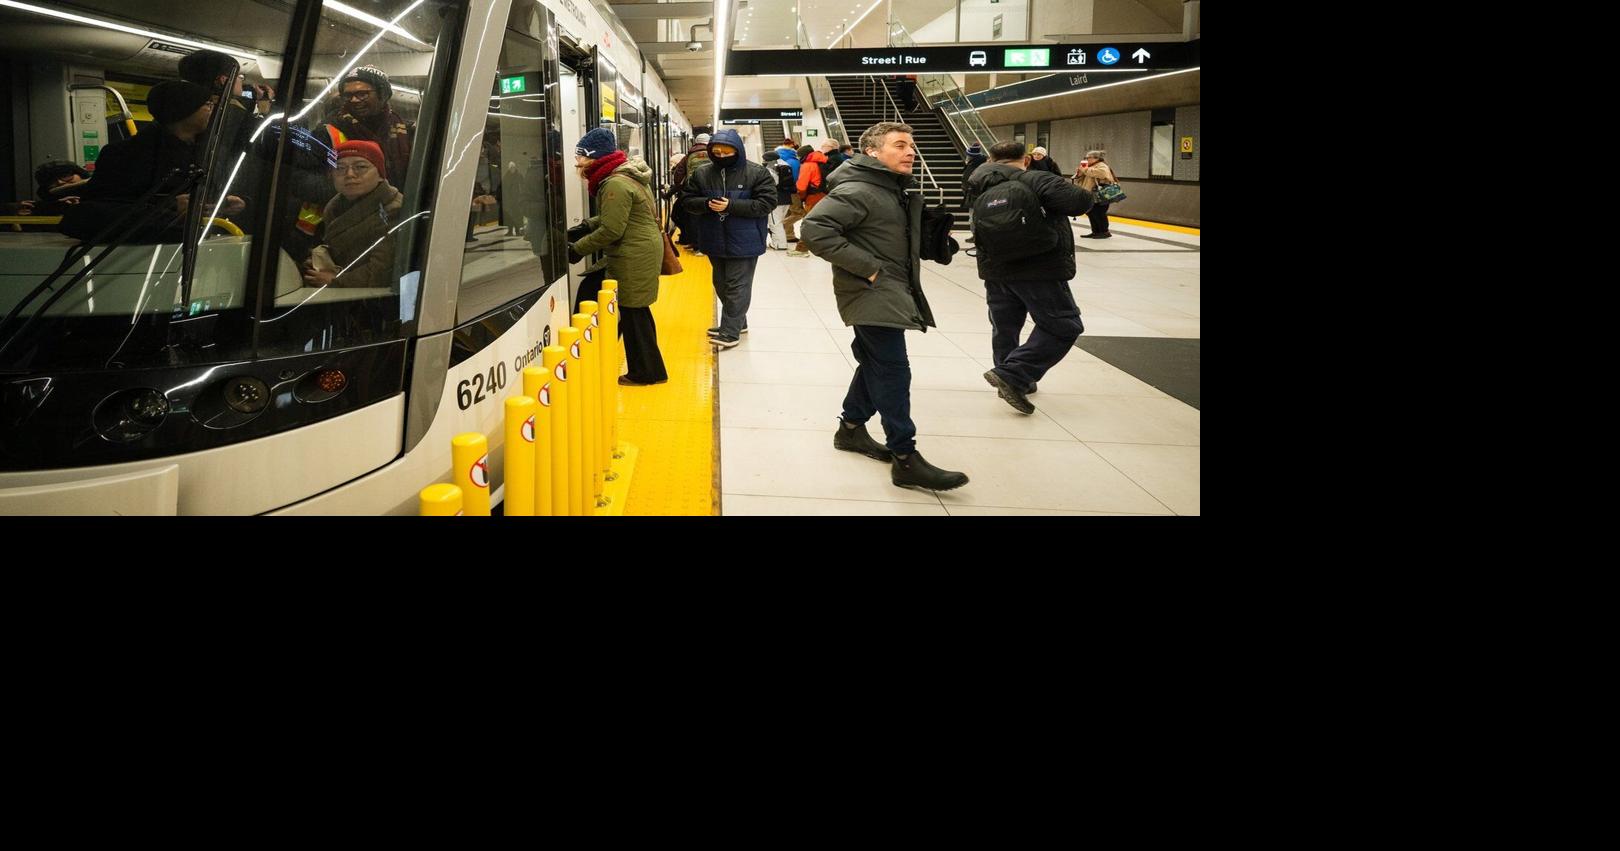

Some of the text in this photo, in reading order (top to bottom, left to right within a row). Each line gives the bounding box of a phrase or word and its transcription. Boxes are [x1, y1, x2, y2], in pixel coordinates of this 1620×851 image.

[861, 56, 896, 65] Street
[905, 55, 927, 64] Rue
[1069, 73, 1088, 86] Laird
[514, 341, 543, 372] Ontario
[457, 361, 506, 410] 6240
